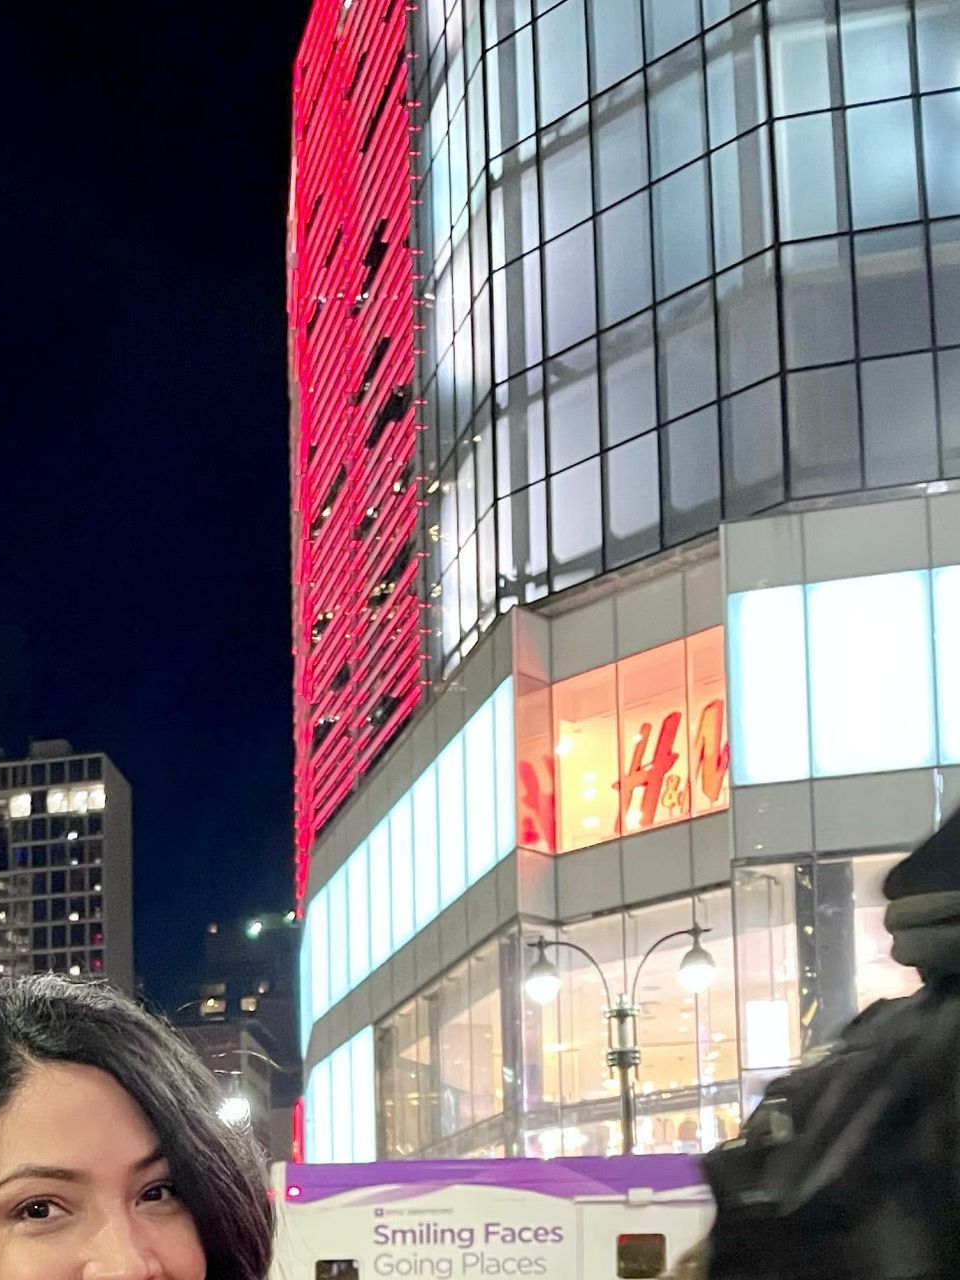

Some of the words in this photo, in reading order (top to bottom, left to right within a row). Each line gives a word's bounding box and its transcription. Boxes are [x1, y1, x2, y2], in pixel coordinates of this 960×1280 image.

[373, 1222, 475, 1248] Smiling
[484, 1222, 564, 1244] Faces
[374, 1252, 453, 1280] Going
[462, 1252, 547, 1276] Places
